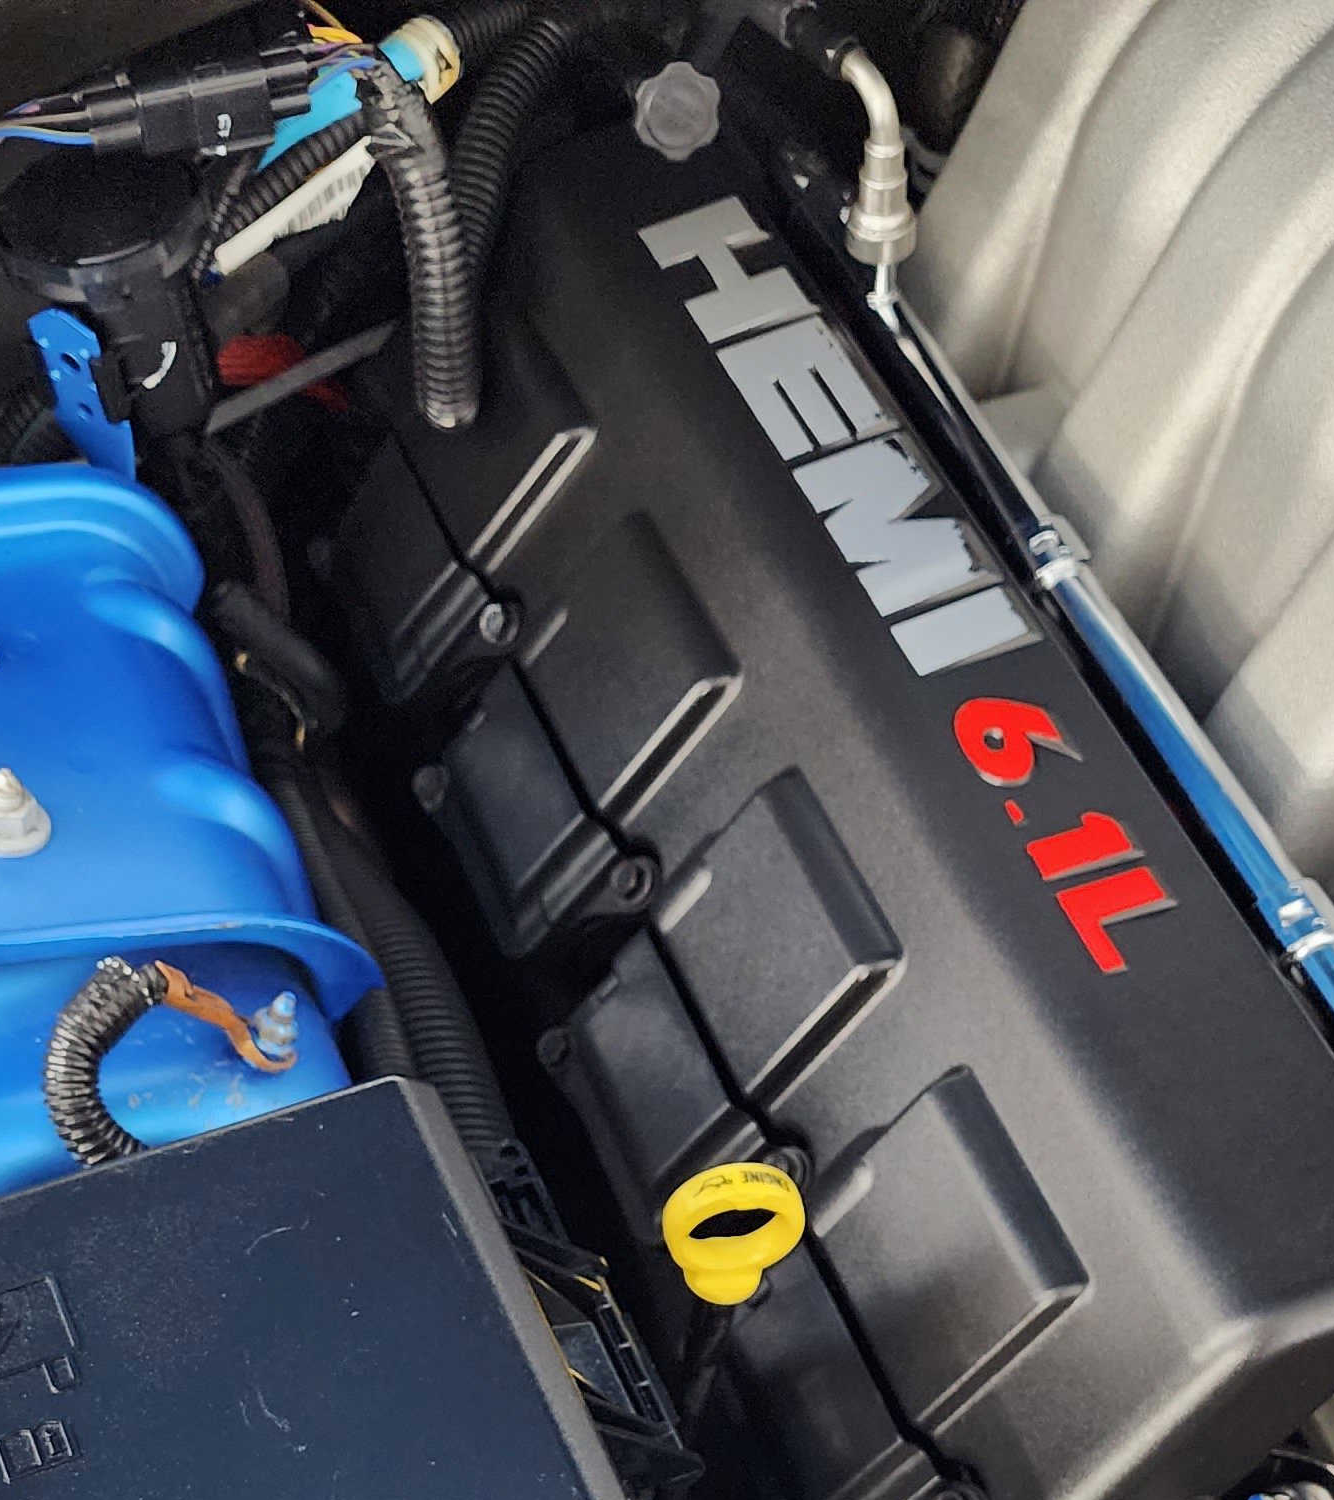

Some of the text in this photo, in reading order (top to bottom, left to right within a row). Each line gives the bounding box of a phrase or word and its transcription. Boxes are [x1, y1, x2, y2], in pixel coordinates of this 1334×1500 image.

[637, 196, 1176, 974] HEMI 6.1L
[740, 1171, 790, 1192] ENGINE
